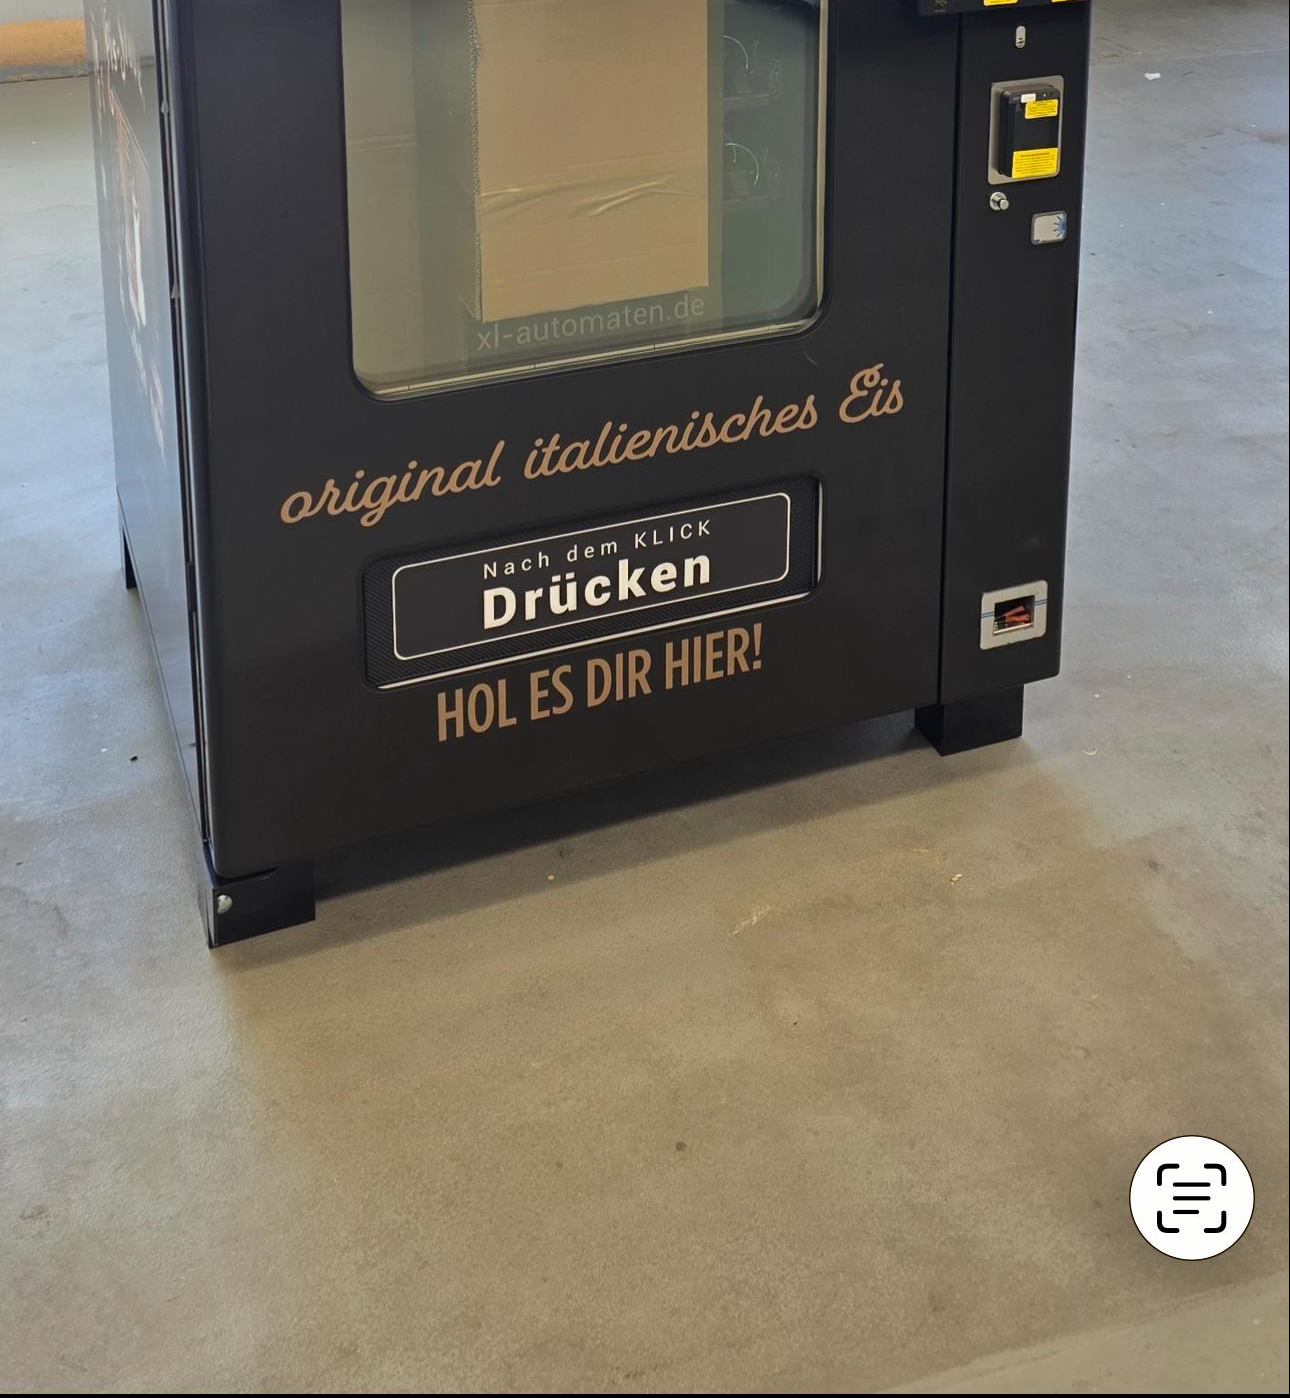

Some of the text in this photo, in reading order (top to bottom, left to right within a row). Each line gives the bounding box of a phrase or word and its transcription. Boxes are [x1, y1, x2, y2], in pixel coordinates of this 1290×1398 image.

[477, 294, 706, 351] xl-automaten.de
[279, 363, 905, 528] original italienisches Eis
[483, 519, 711, 580] Nach dem KLICK
[483, 554, 711, 630] Drücken
[437, 622, 763, 743] HOL ES DIR HIER!
